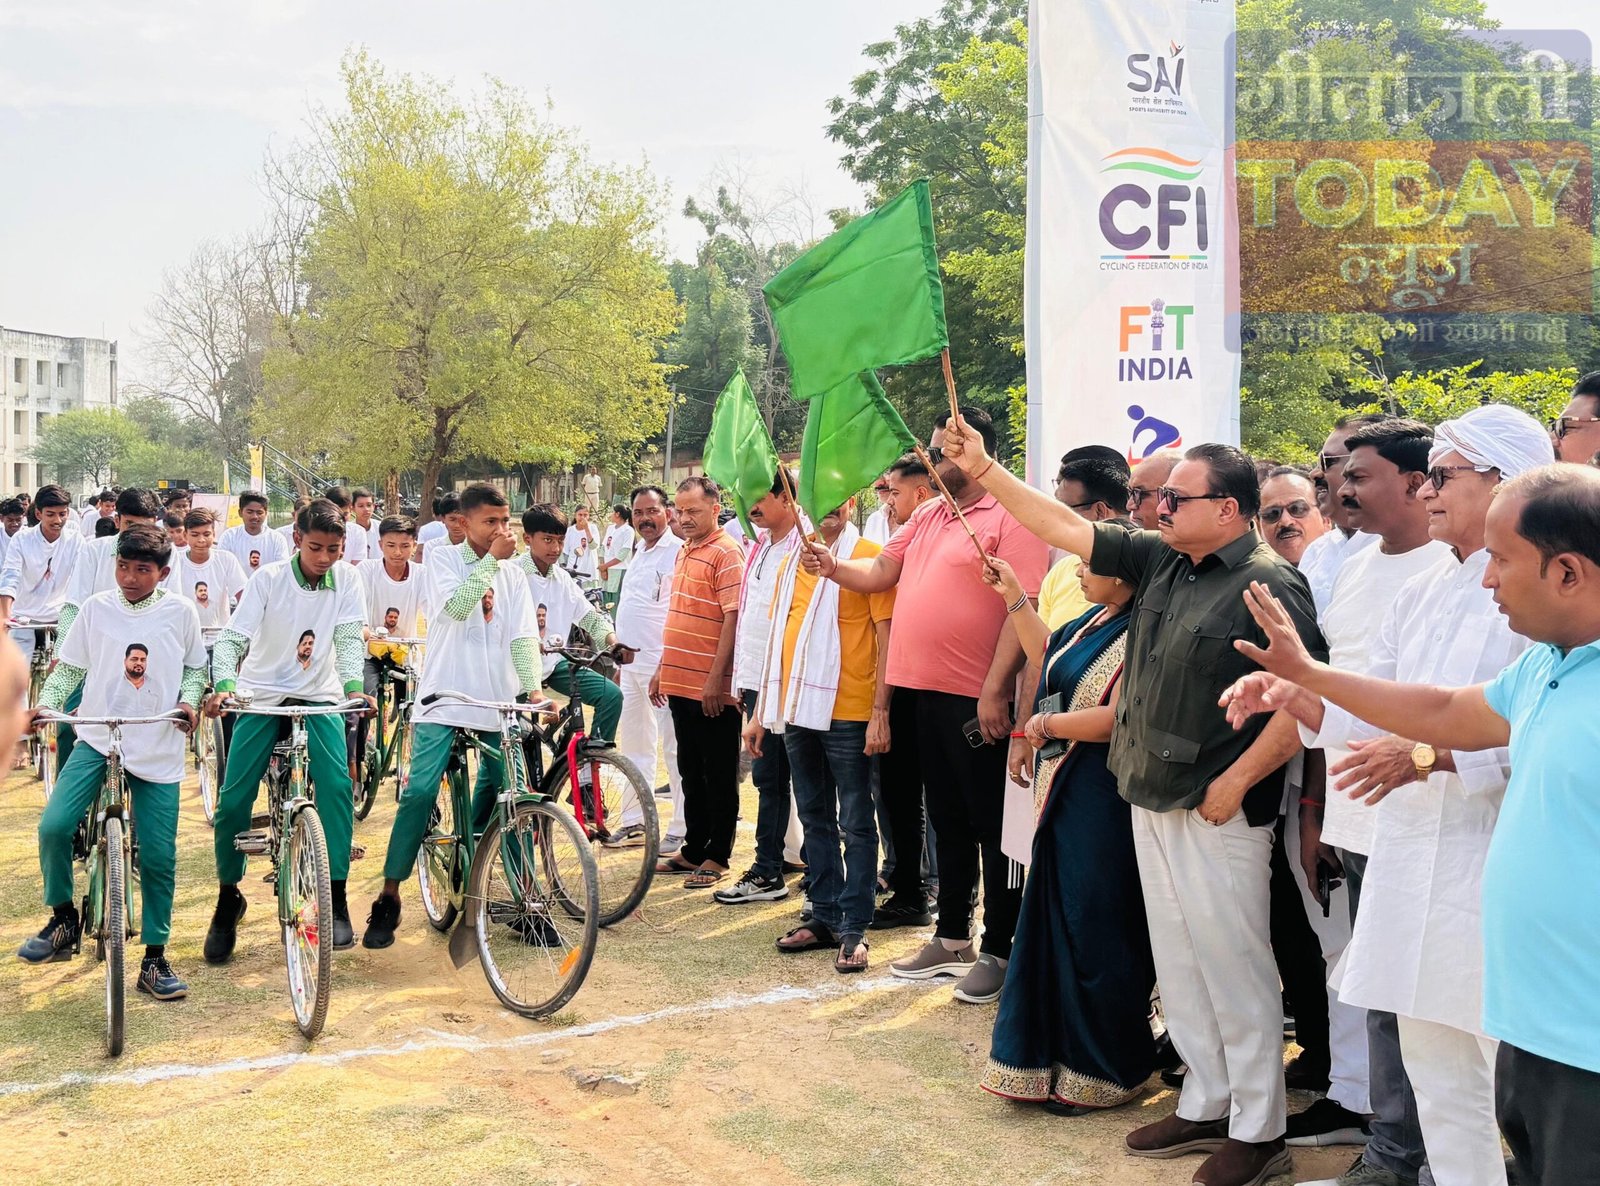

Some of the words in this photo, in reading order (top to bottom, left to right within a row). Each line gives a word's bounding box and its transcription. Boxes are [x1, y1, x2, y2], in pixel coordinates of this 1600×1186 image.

[1127, 53, 1184, 96] SAI
[1099, 183, 1208, 251] CFI
[1100, 262, 1135, 270] CYCLING
[1137, 262, 1179, 270] FEDERATION
[1180, 262, 1190, 270] OF
[1191, 262, 1208, 270] INDIA
[1118, 356, 1193, 382] INDIA
